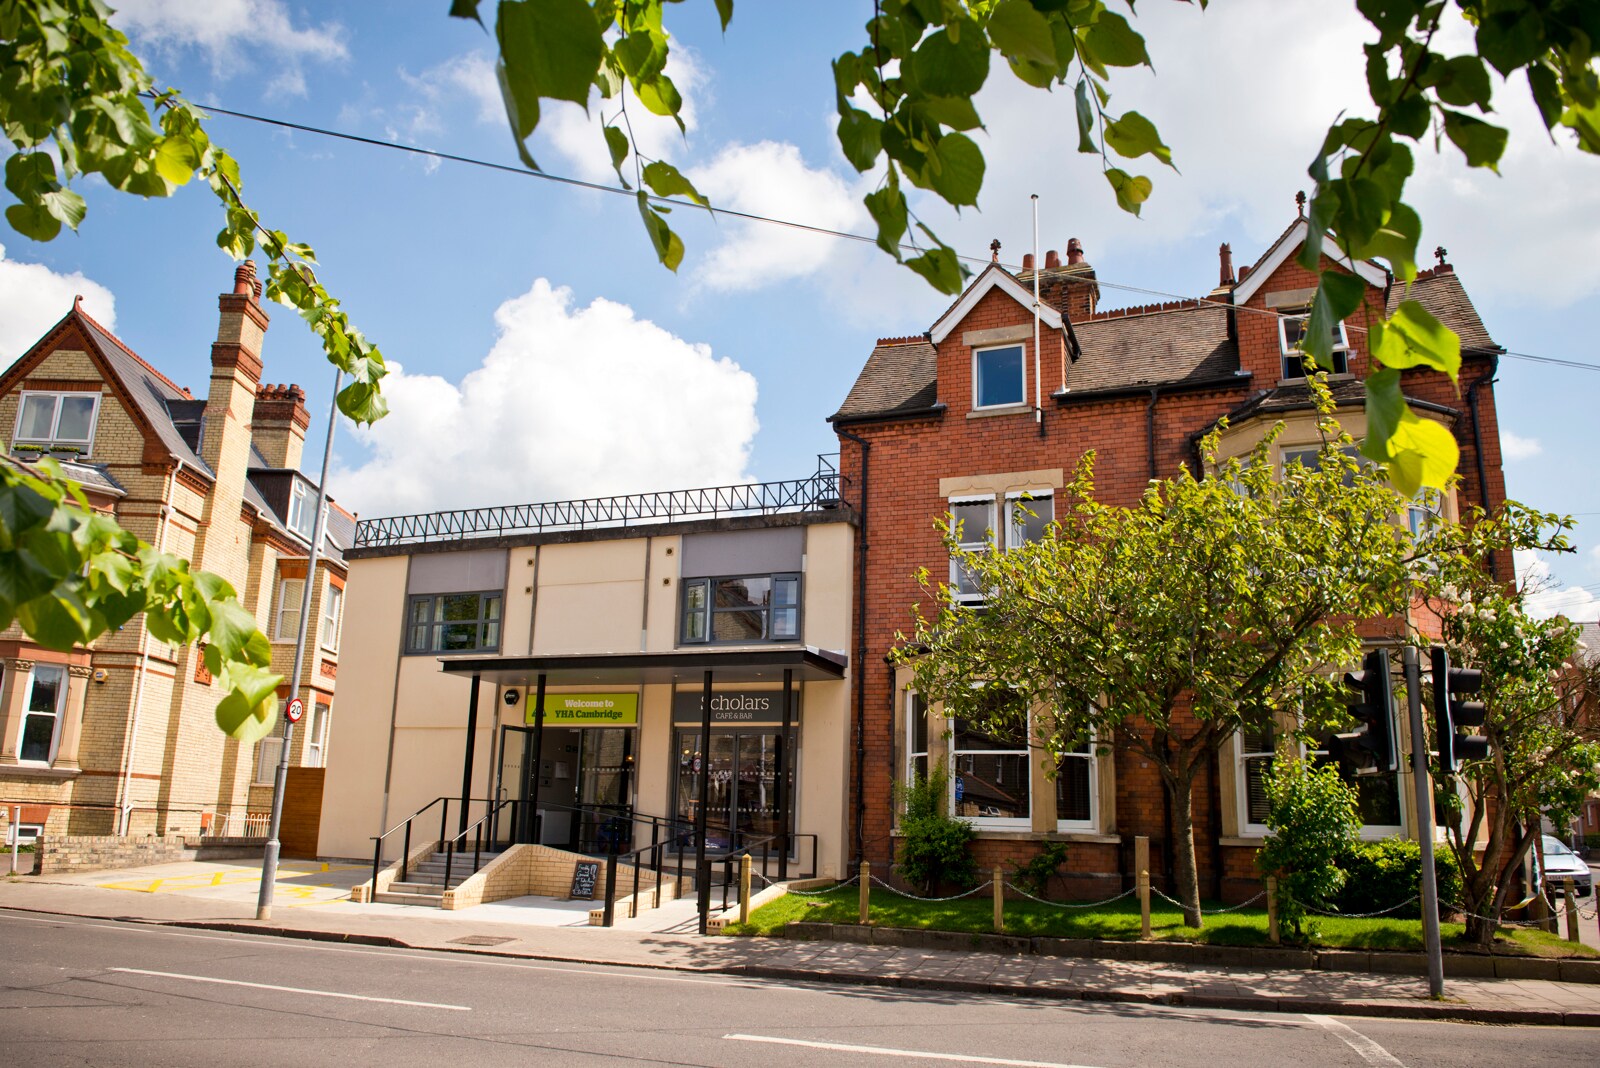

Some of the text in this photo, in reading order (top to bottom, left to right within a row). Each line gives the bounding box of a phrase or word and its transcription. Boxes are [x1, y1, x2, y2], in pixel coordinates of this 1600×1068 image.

[564, 700, 614, 708] Welcome to
[291, 704, 302, 714] 20
[555, 710, 622, 720] YHA Cambridge
[715, 712, 733, 720] CAFÉ
